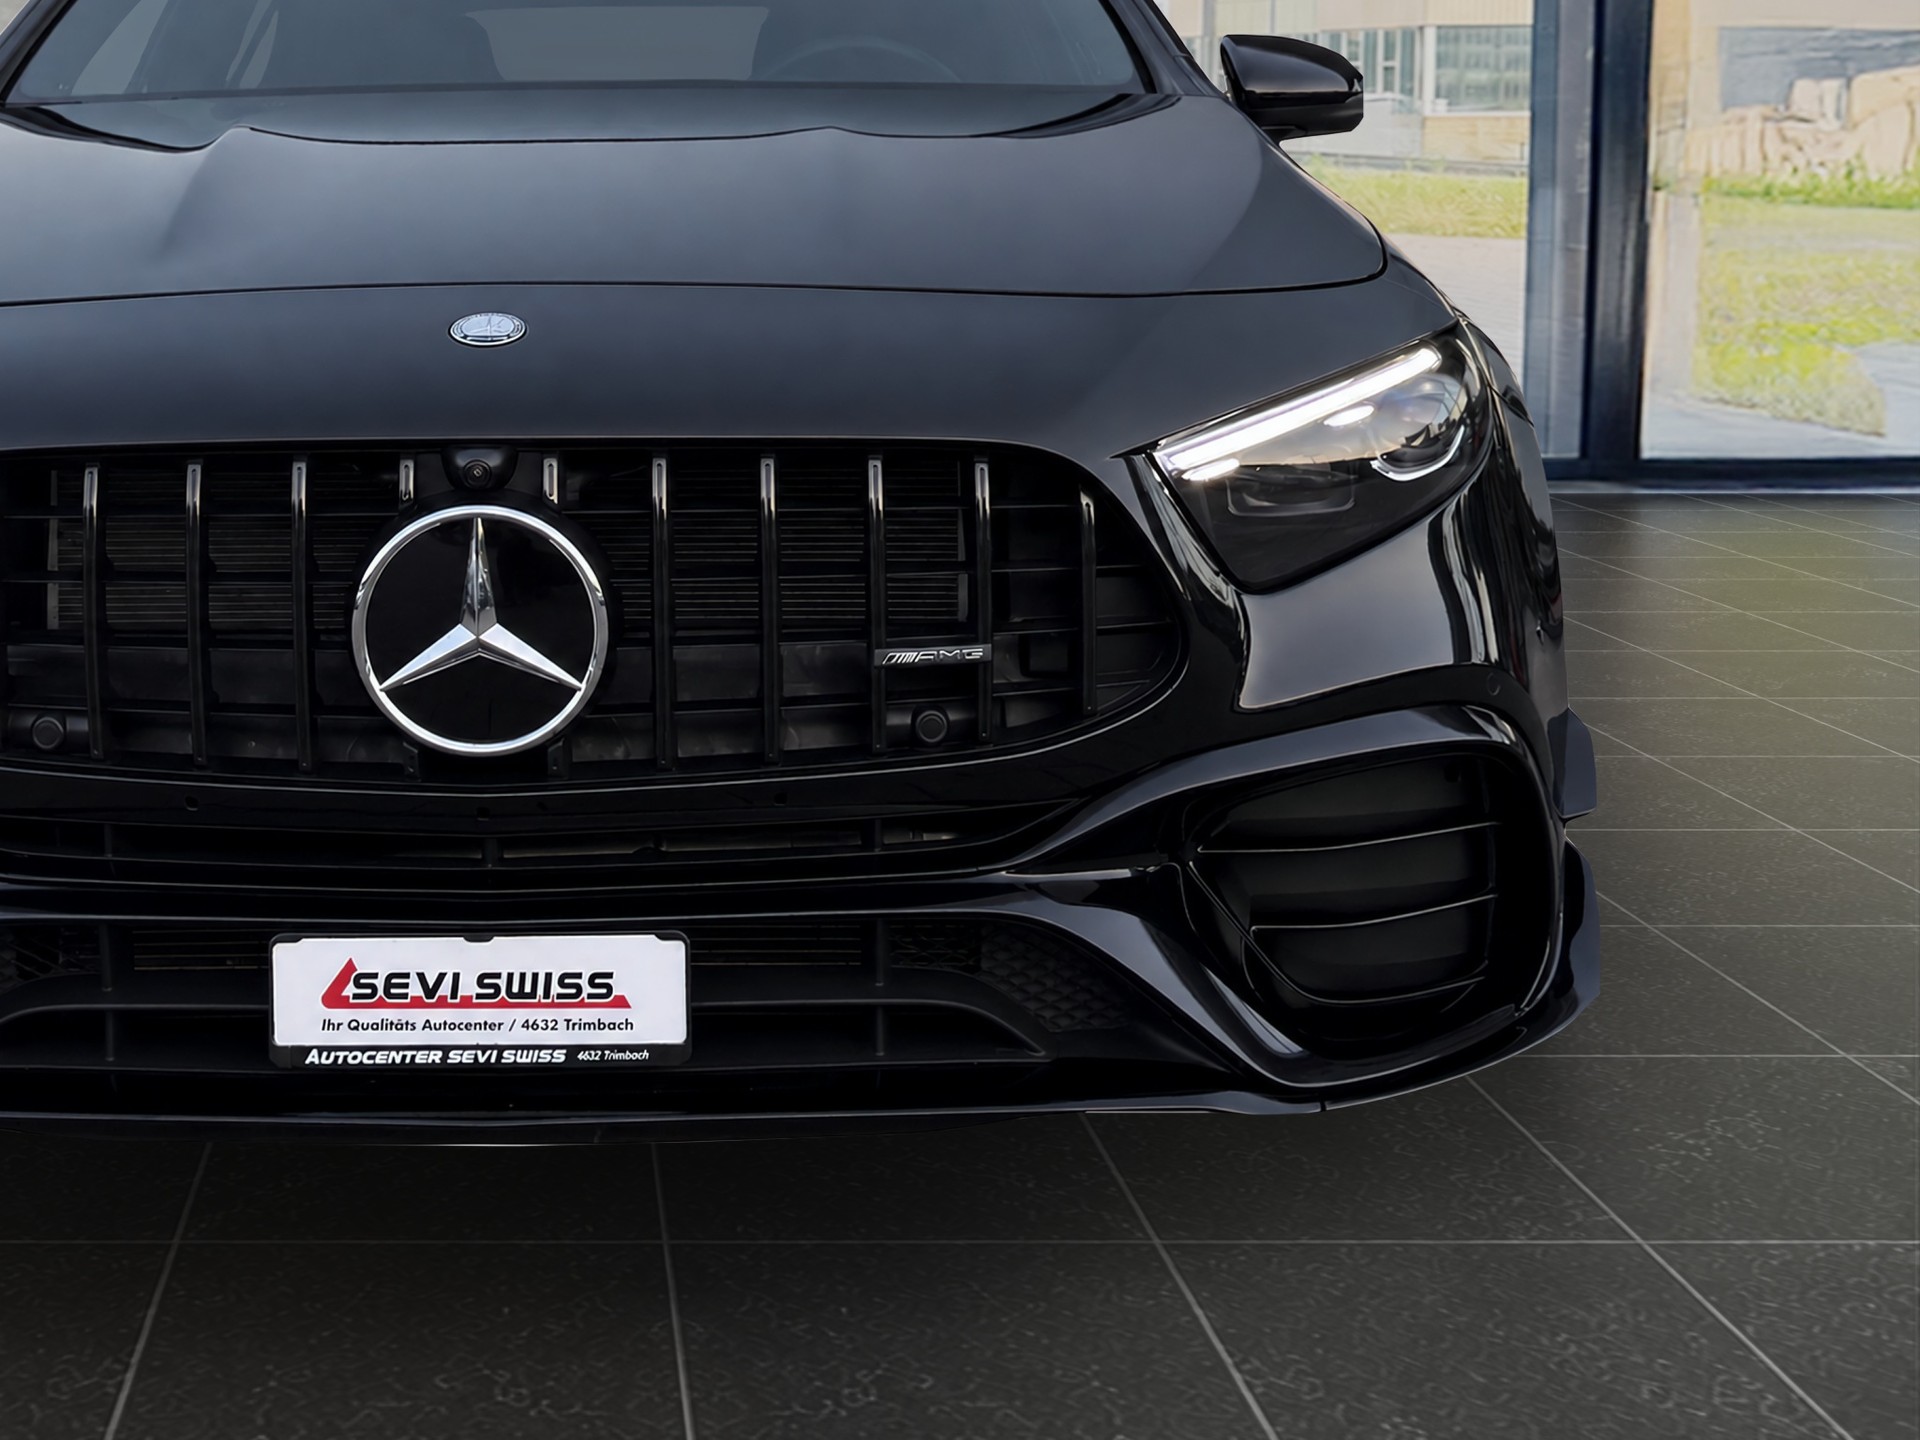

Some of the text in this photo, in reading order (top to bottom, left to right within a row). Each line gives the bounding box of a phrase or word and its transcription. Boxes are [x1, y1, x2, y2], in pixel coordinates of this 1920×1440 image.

[351, 972, 615, 1001] SEVI SWISS
[321, 1018, 634, 1032] Ihr Qualitäts Autocenter / 4632 Trimbach
[305, 1048, 568, 1065] AUTOCENTER SEVI SWISS
[577, 1049, 650, 1062] 4632 Trimbach
